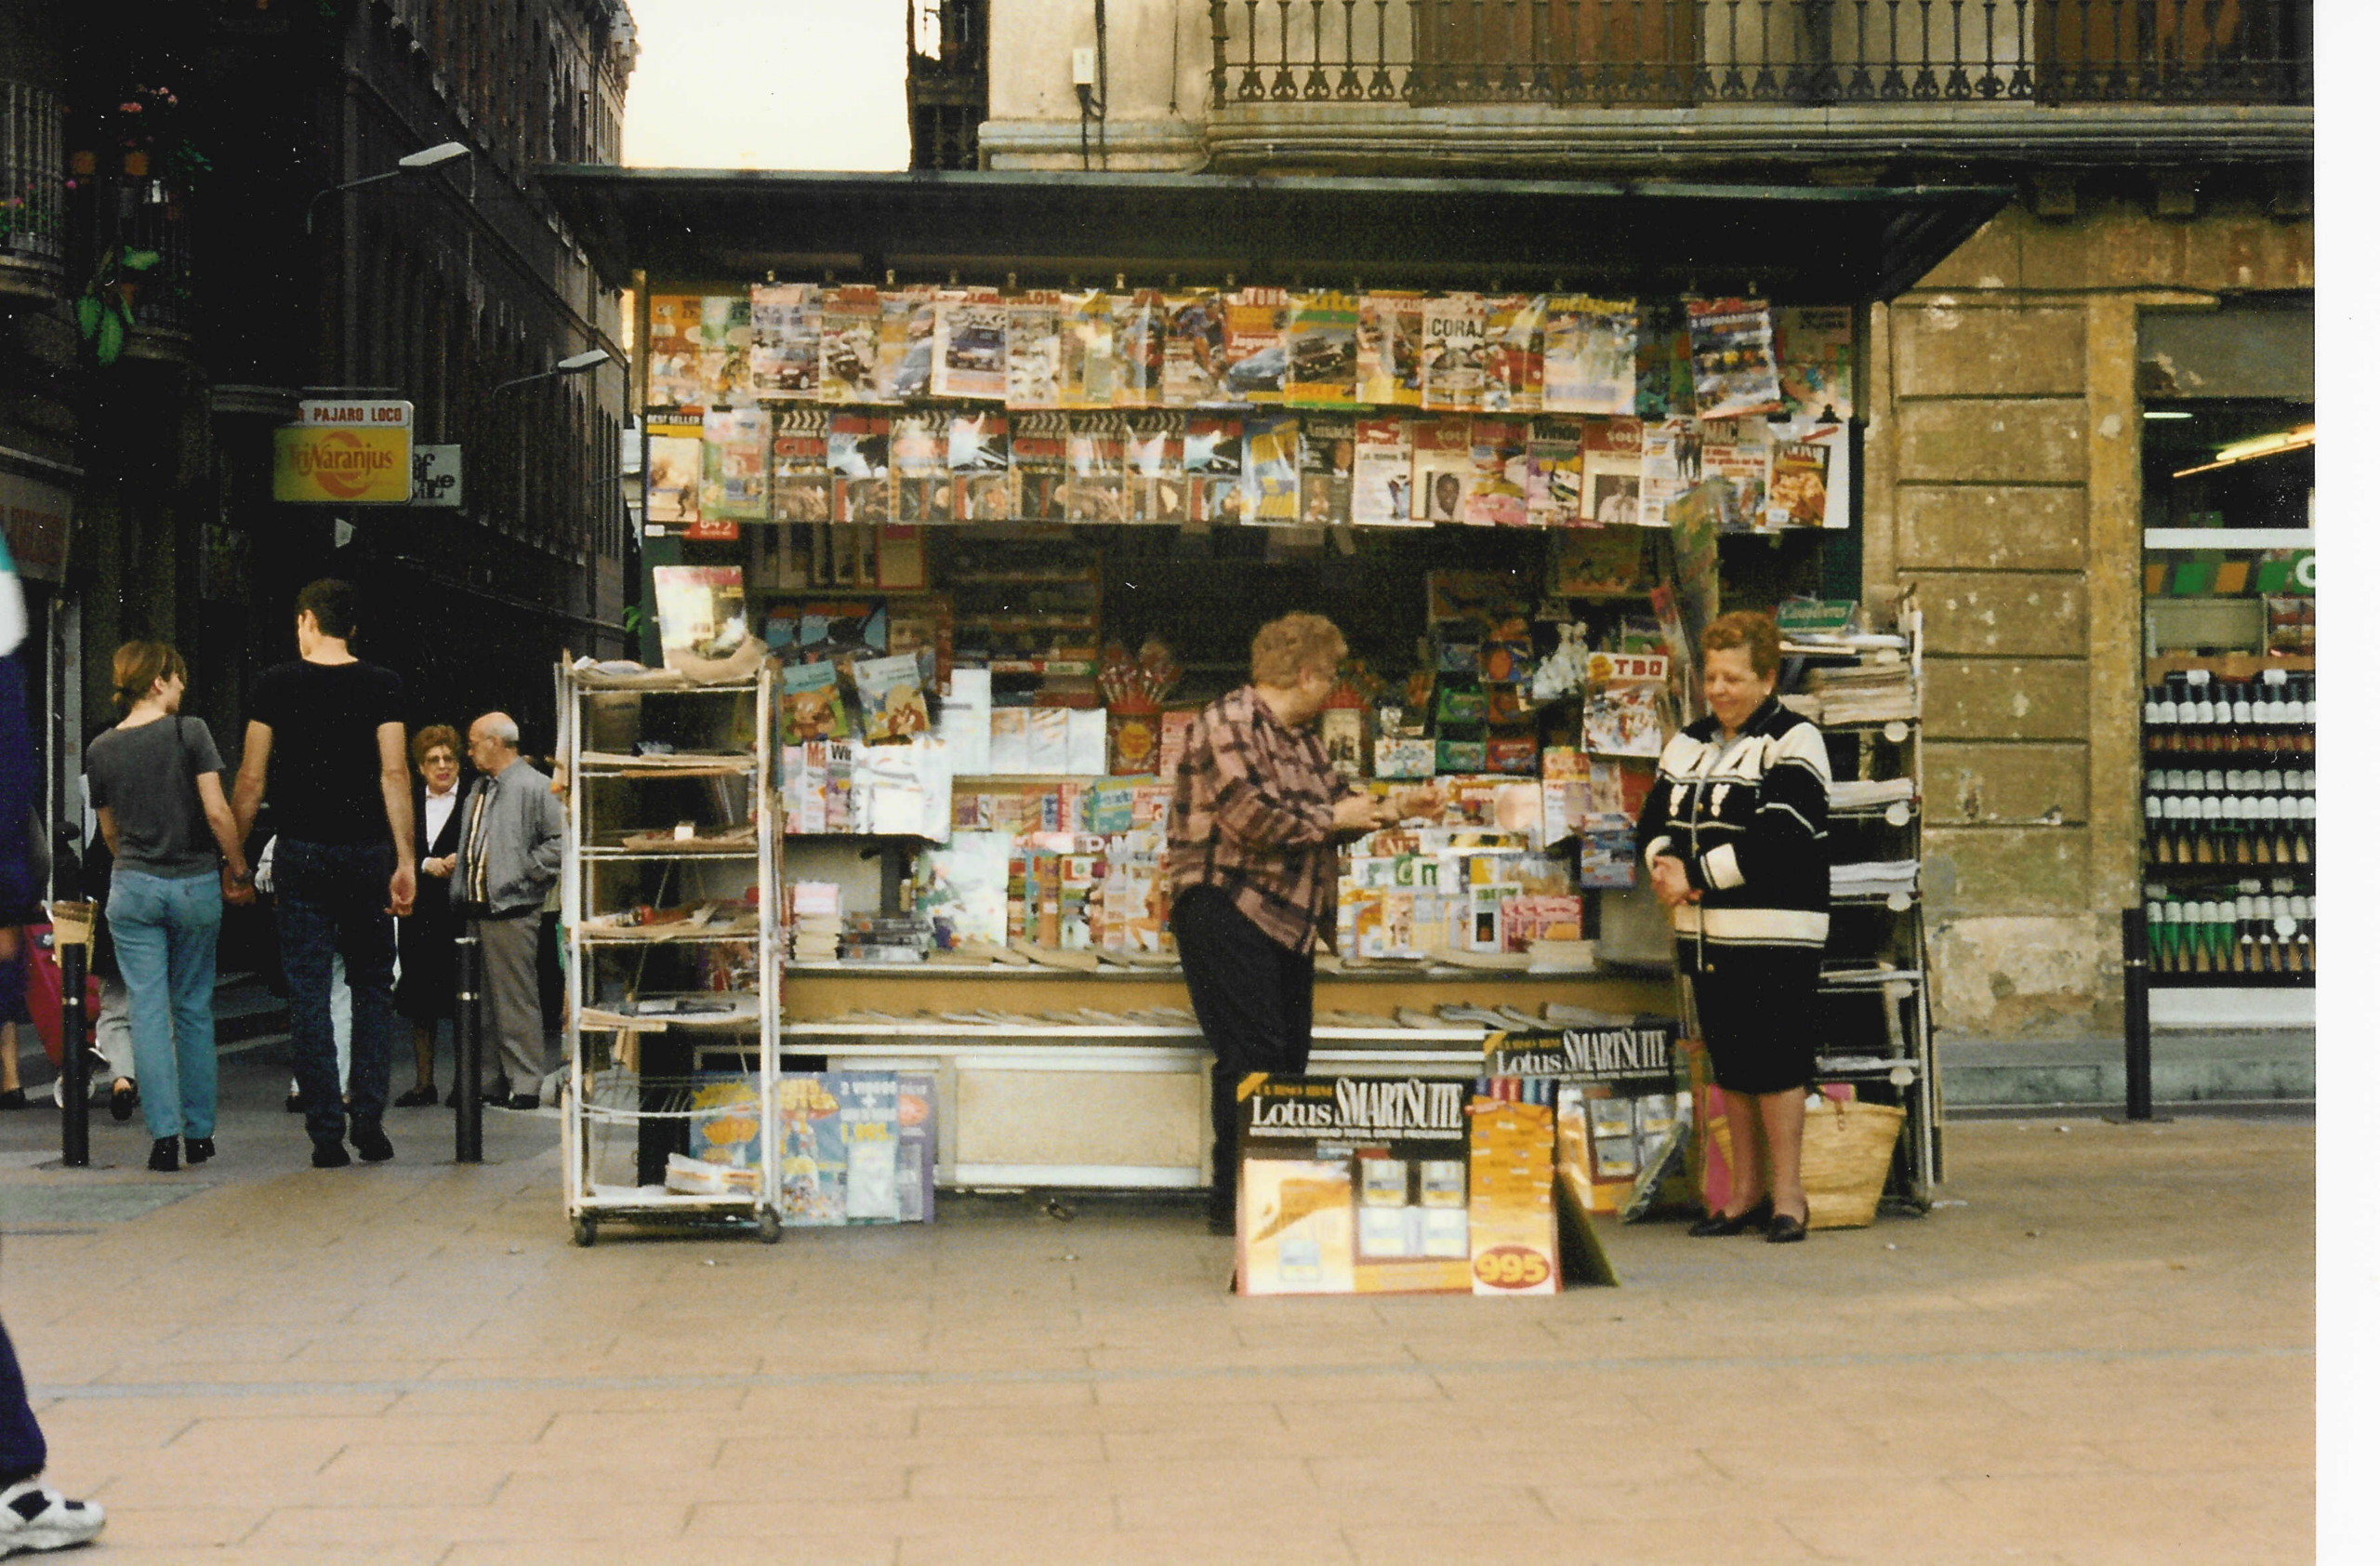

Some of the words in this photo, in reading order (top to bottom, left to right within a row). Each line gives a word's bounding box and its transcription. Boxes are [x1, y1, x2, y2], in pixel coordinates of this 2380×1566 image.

[313, 407, 364, 422] PAJARO
[371, 407, 402, 422] LOCO
[1614, 659, 1662, 677] TBO
[1496, 1050, 1562, 1076] Lotus
[1251, 1095, 1332, 1127] Lotus
[1475, 1253, 1546, 1283] 995
